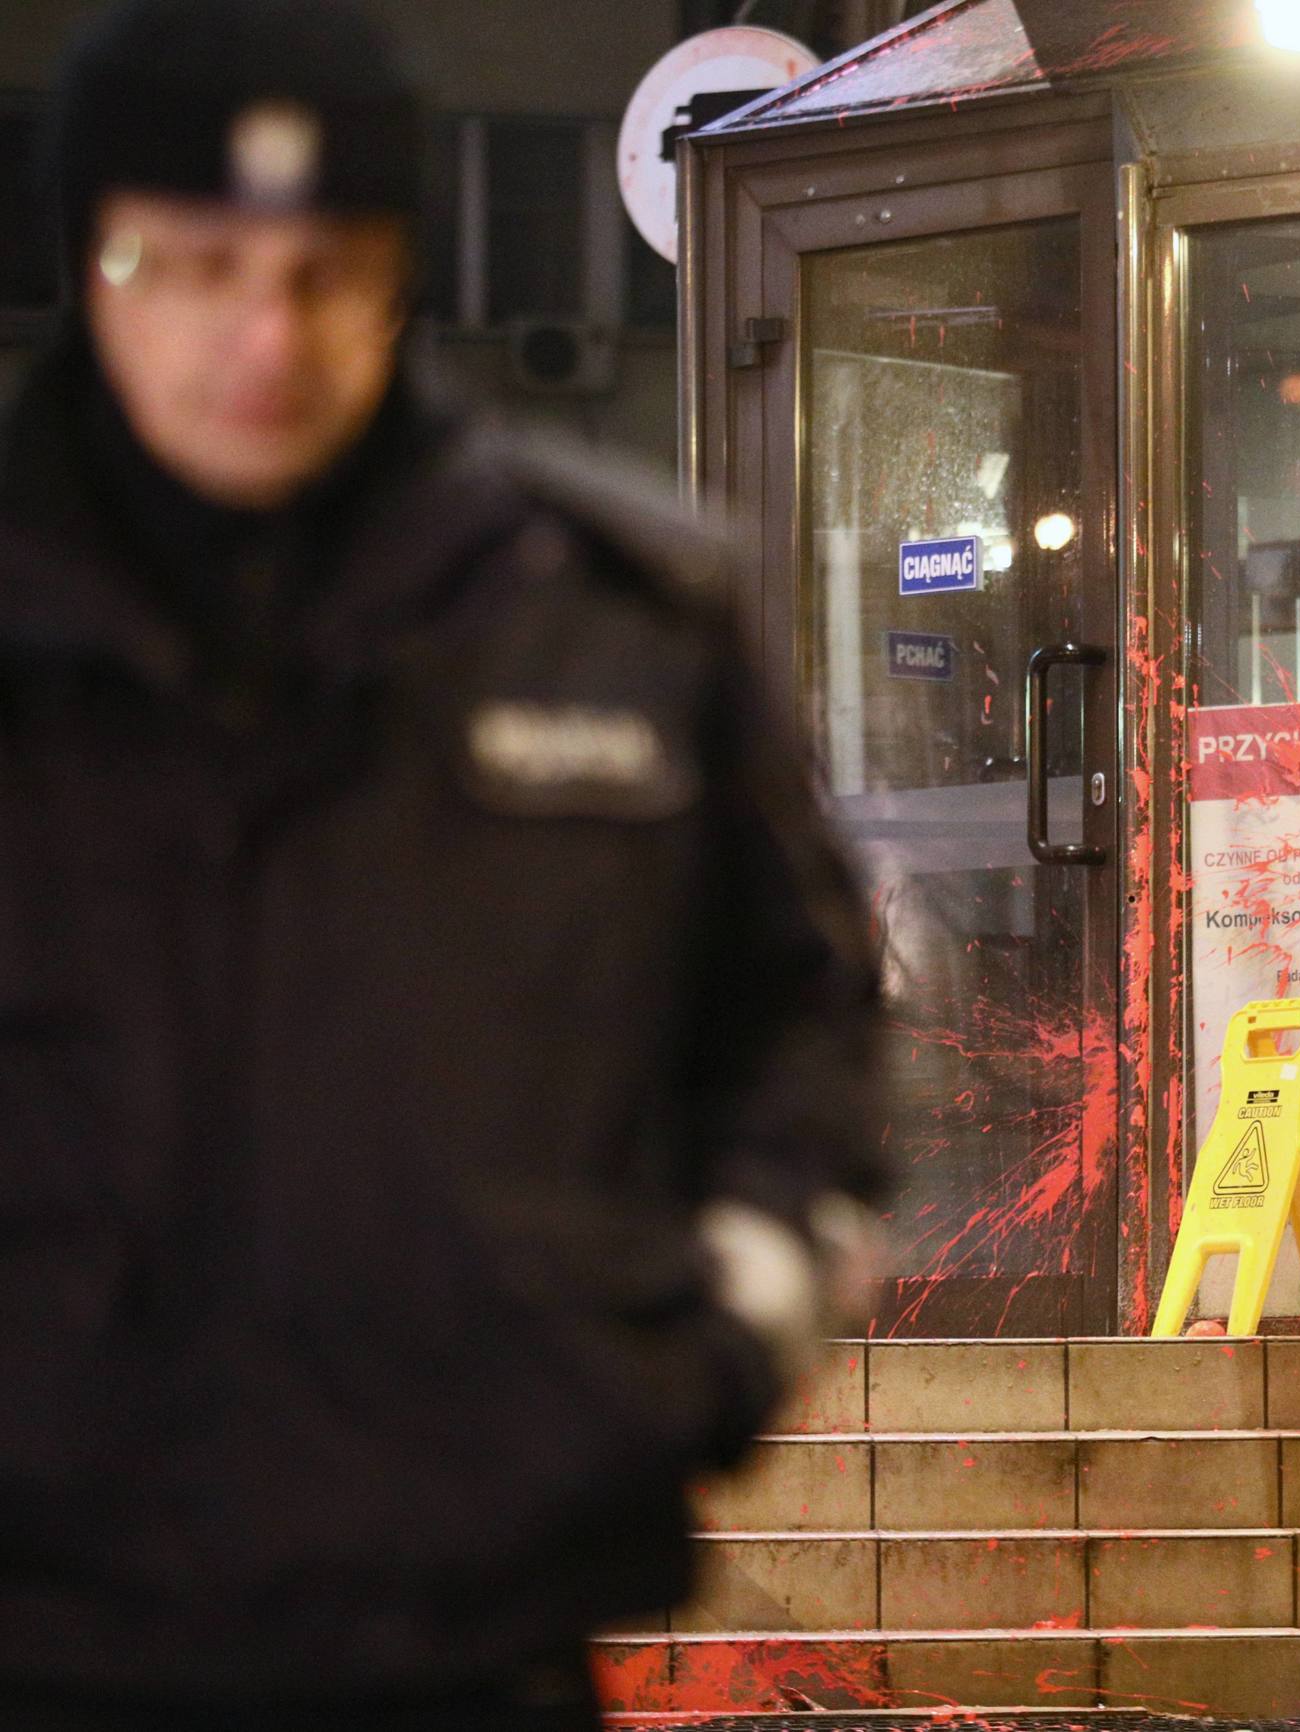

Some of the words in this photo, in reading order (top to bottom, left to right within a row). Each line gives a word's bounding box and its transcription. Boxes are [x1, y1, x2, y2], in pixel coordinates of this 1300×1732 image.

[904, 545, 973, 583] CIĄGNĄĆ
[896, 641, 945, 668] PCHAĆ
[1204, 850, 1262, 867] CZYNNE
[1238, 1105, 1283, 1120] CAUTION
[1209, 1198, 1232, 1210] WET
[1232, 1195, 1265, 1208] FLOOR
